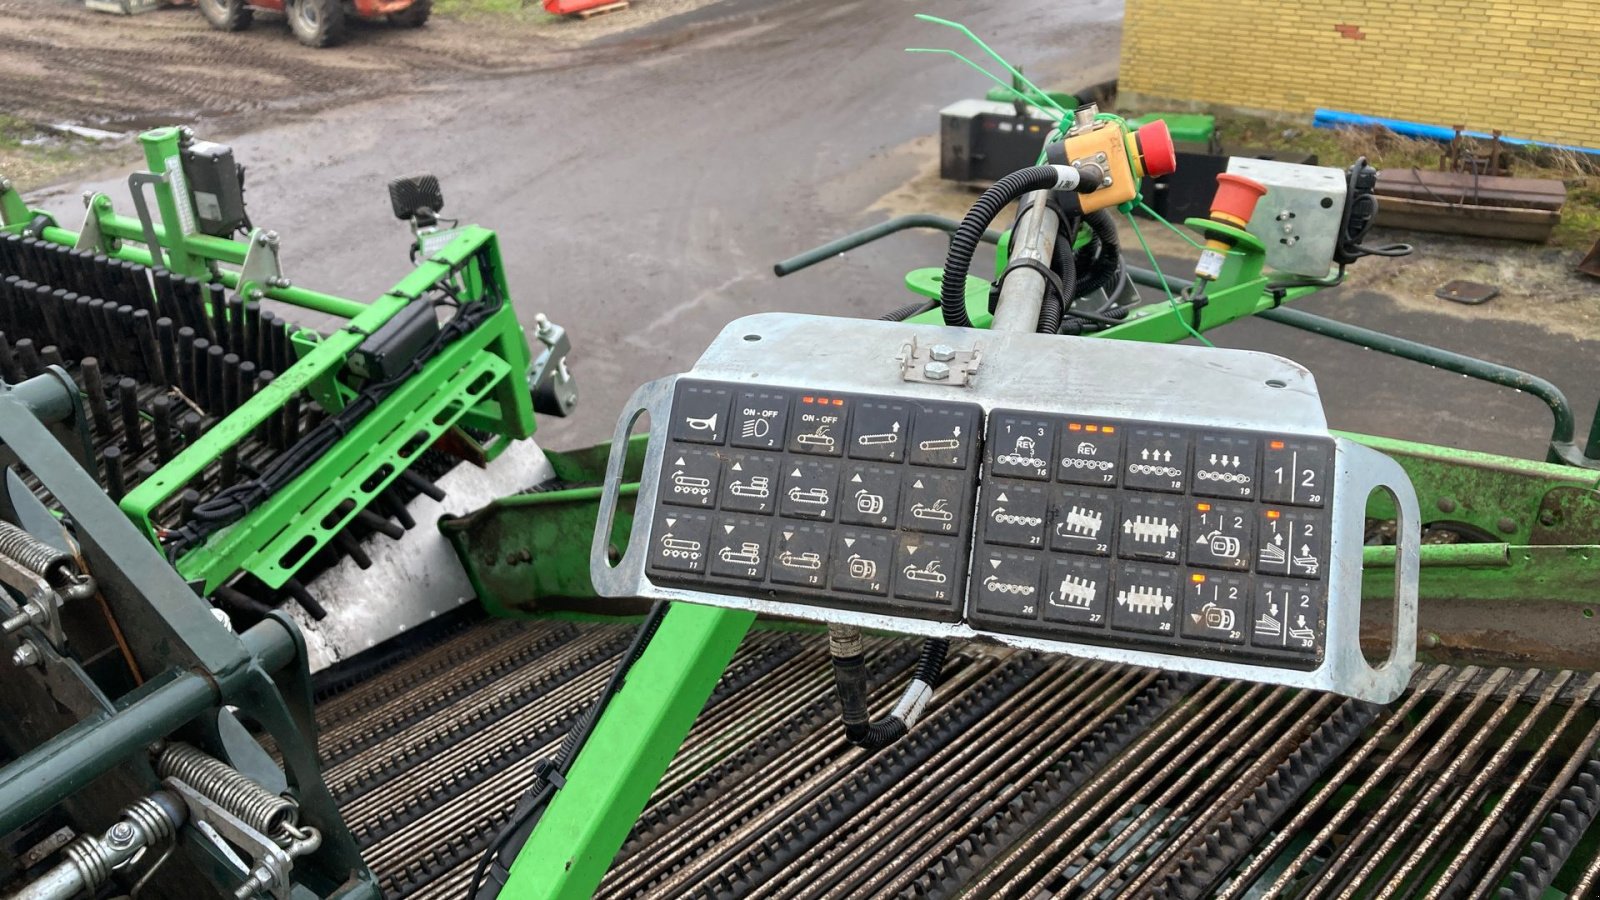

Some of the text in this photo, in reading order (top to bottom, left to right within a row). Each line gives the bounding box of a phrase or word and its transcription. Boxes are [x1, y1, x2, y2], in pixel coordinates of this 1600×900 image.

[743, 408, 756, 416] ON
[762, 409, 779, 418] OFF
[802, 414, 815, 422] ON
[821, 416, 838, 424] OFF
[1006, 425, 1044, 436] 1 3
[1016, 440, 1036, 449] REV
[1077, 447, 1098, 456] REV
[1274, 466, 1316, 487] 1 2
[1171, 480, 1182, 488] 18
[1240, 488, 1250, 496] 19
[1309, 494, 1321, 503] 20
[1200, 513, 1243, 529] 1 2
[942, 523, 952, 531] 10
[1270, 520, 1314, 537] 1 2
[1030, 536, 1040, 544] 21
[1096, 544, 1108, 552] 22
[1165, 552, 1176, 560] 23
[1305, 566, 1317, 574] 25
[809, 575, 818, 583] 13
[870, 582, 880, 591] 14
[1194, 584, 1238, 600] 1 2
[1266, 591, 1310, 608] 1 2
[1022, 606, 1034, 614] 26
[1090, 614, 1102, 622] 27
[1160, 622, 1171, 631] 28
[1228, 631, 1241, 640] 29
[1302, 640, 1314, 648] 30
